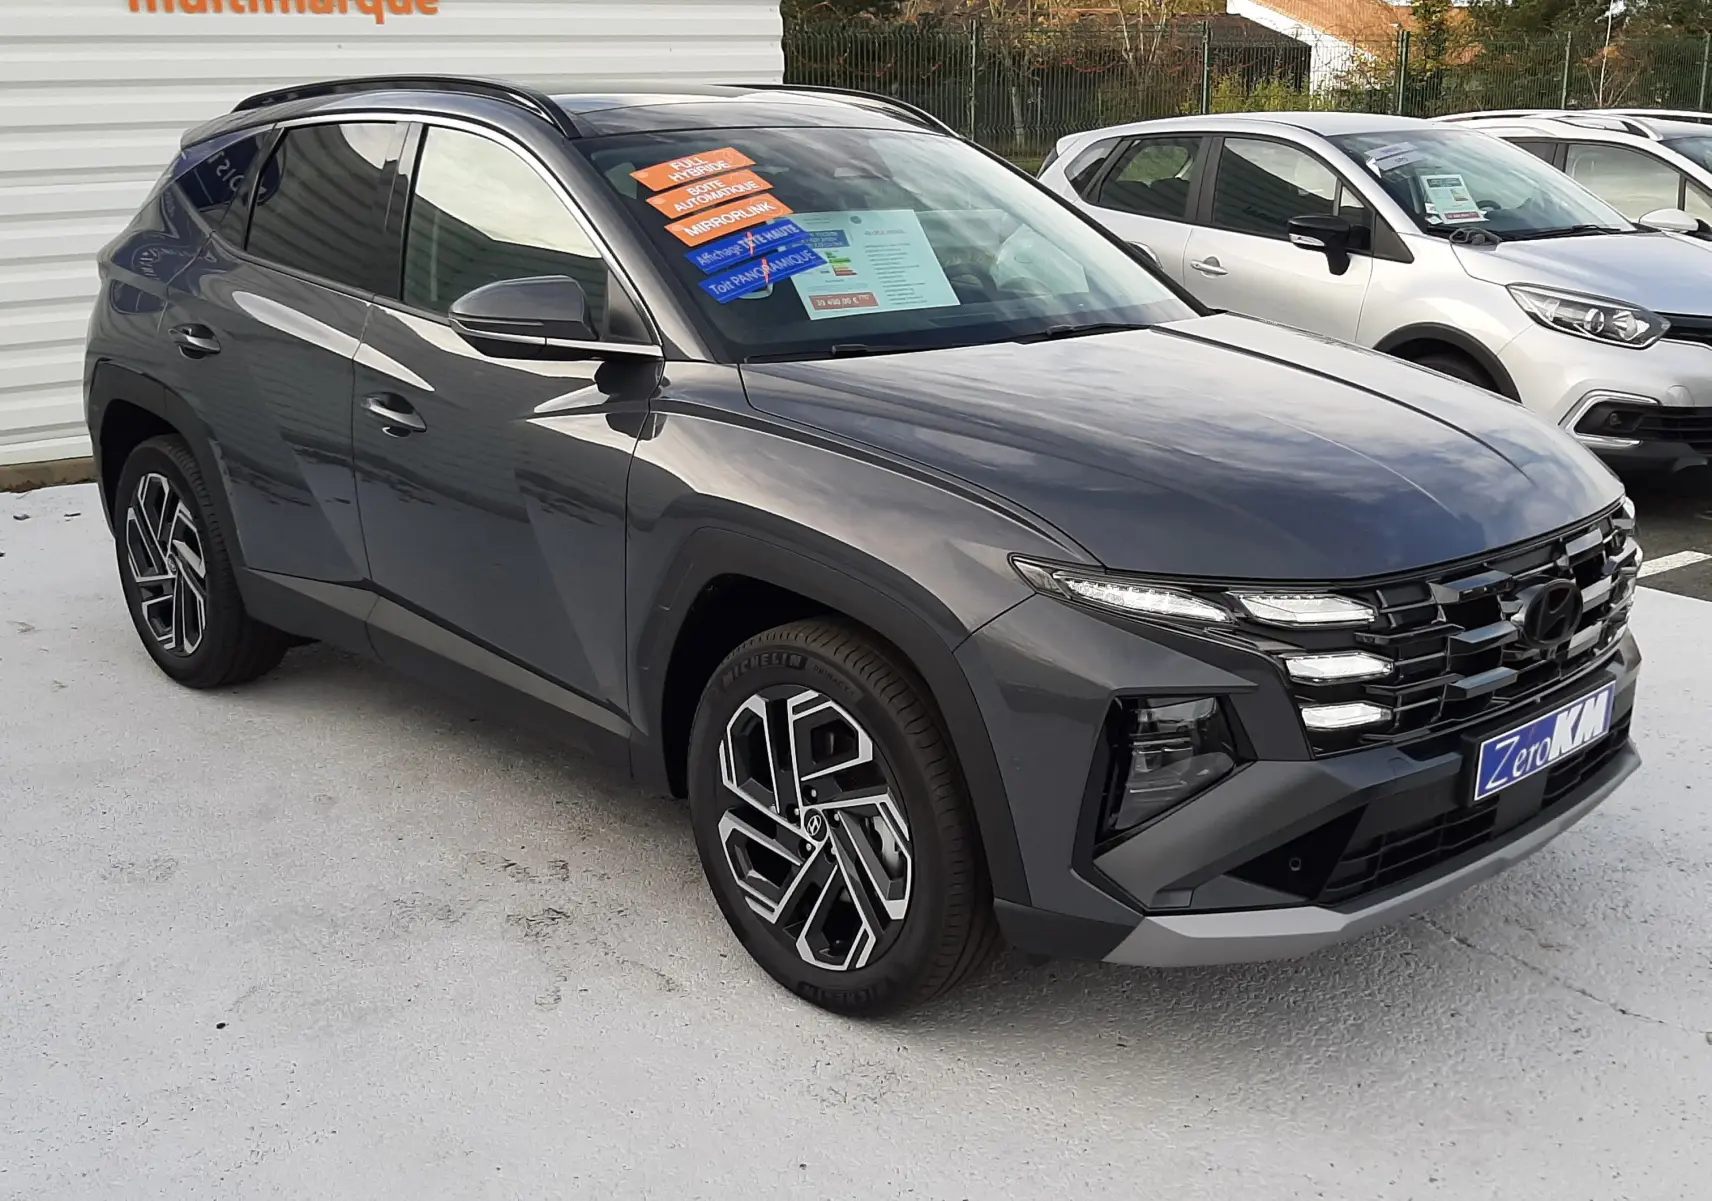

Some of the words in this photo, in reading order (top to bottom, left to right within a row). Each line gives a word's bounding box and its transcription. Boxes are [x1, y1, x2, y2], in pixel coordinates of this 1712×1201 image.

[667, 160, 731, 182] HYBRIDE
[669, 156, 708, 170] FULL
[673, 180, 760, 212] AUTOMATIQUE
[686, 179, 726, 196] BOITE
[683, 202, 776, 237] MIRRORLINK
[762, 224, 799, 241] HAUTE
[709, 280, 734, 295] Toit
[731, 249, 816, 286] PANORAMIQUE
[721, 652, 802, 689] MICHELIN
[1485, 690, 1609, 790] ZeroKM
